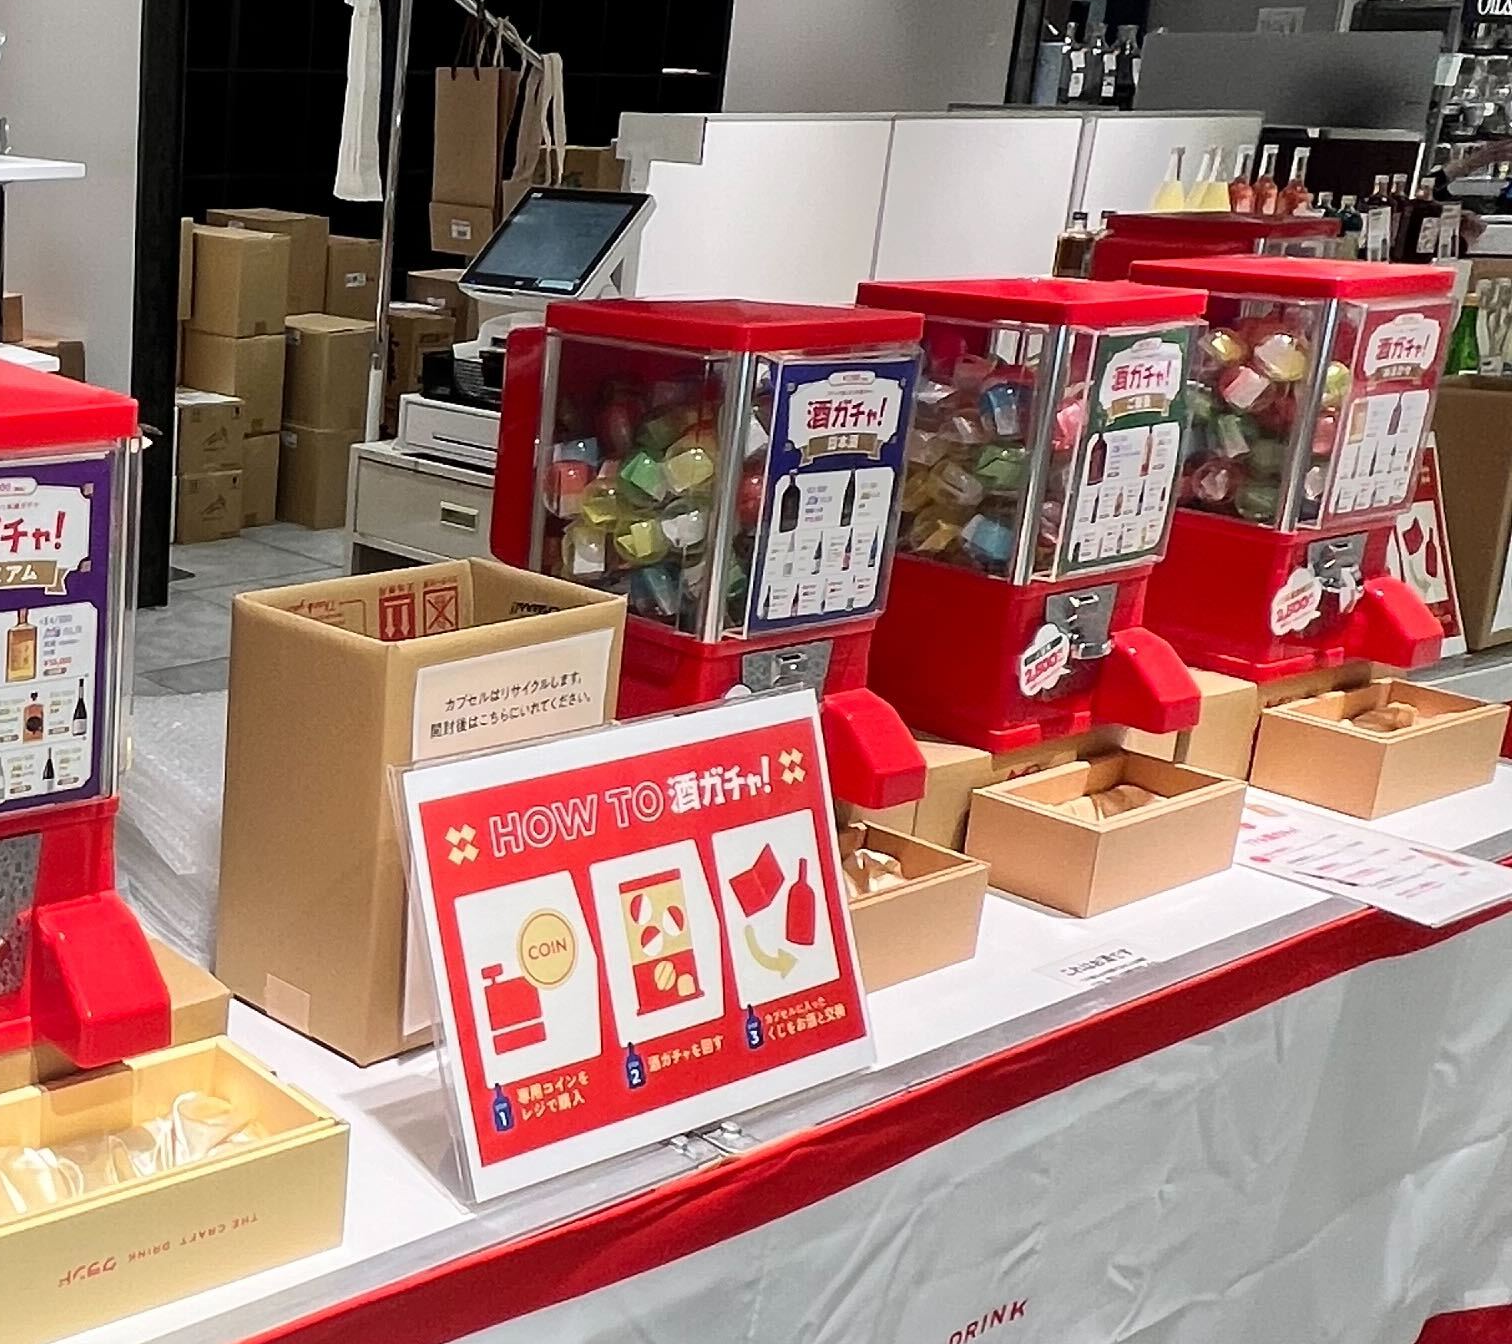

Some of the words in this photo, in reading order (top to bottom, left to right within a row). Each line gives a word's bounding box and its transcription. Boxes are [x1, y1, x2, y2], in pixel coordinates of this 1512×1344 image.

[488, 793, 599, 859] HOW
[604, 779, 665, 831] TO
[528, 936, 569, 961] COIN
[749, 1030, 760, 1045] 3
[630, 1069, 642, 1084] 2
[498, 1111, 508, 1127] 1
